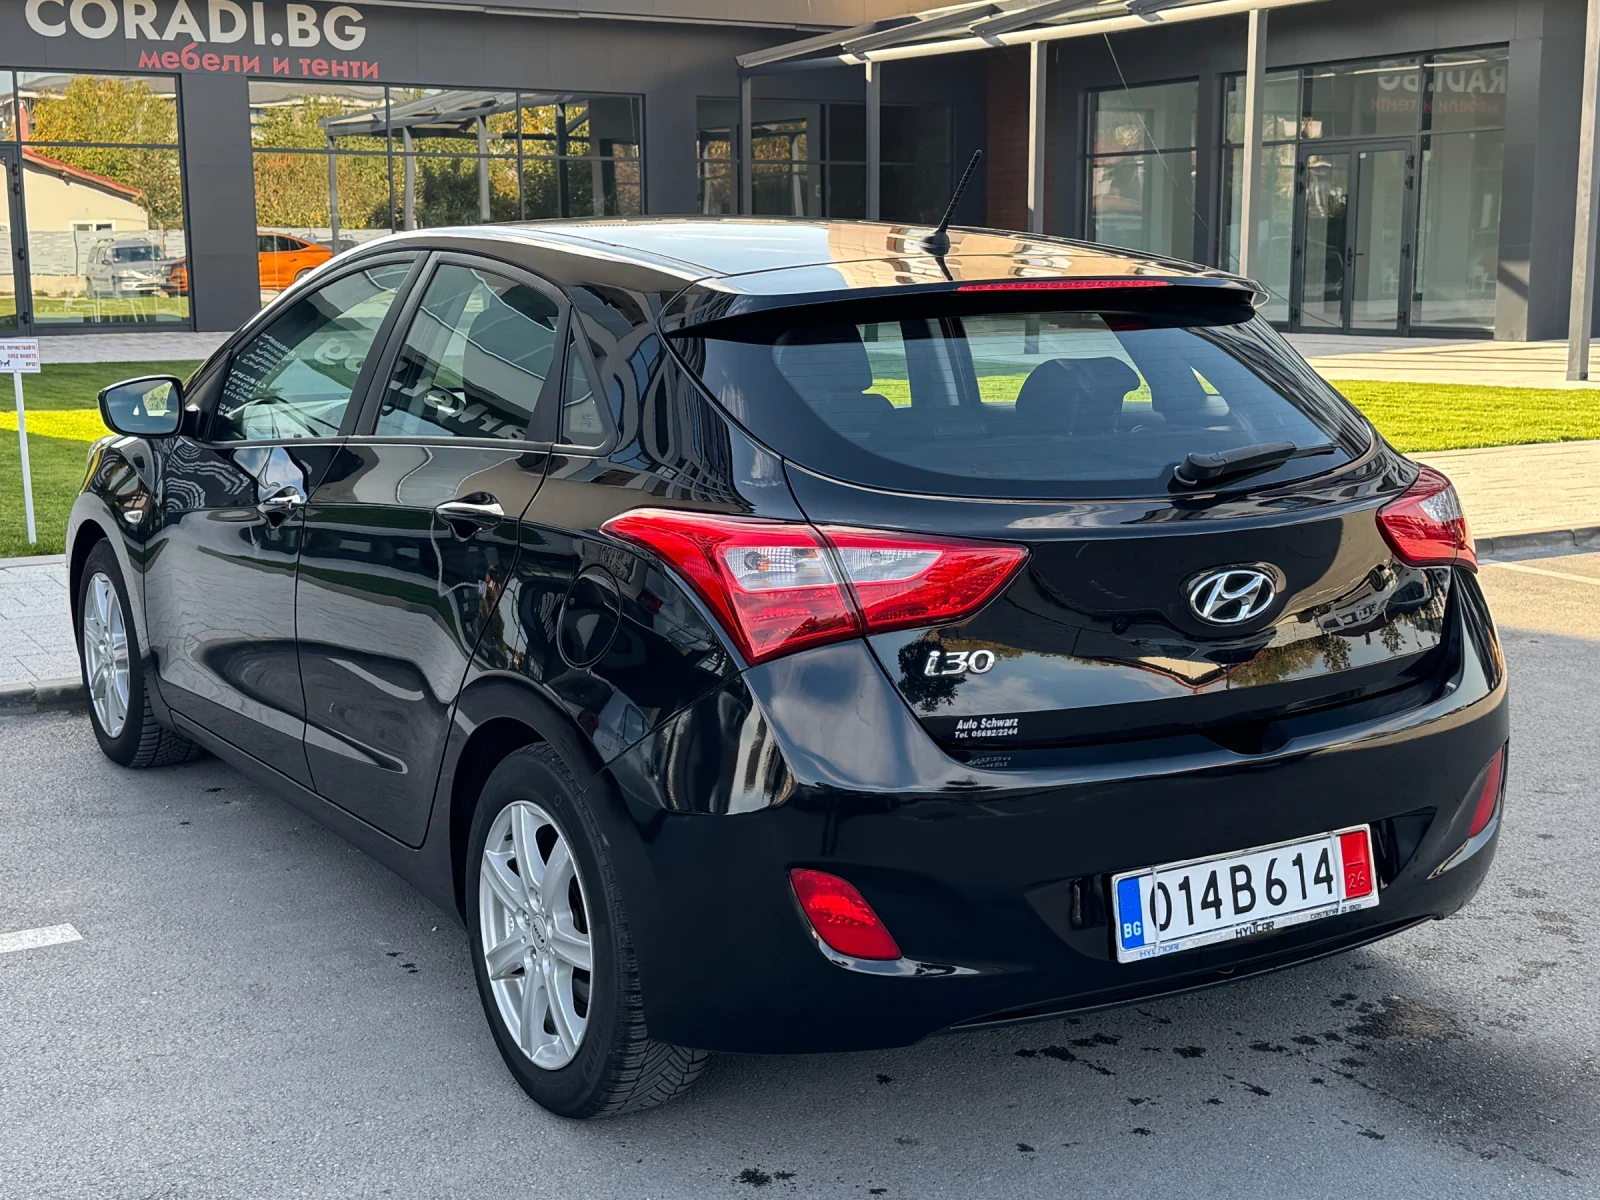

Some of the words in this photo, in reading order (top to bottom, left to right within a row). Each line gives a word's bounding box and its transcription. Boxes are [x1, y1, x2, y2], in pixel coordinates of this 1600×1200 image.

[25, 0, 366, 51] CORADI.BG
[138, 42, 260, 74] мебели
[273, 57, 290, 75] и
[299, 58, 379, 79] тенти
[924, 650, 995, 676] i30
[956, 719, 978, 730] Auto
[980, 717, 1019, 729] Schwarz
[971, 728, 1018, 738] 05692/2244
[1149, 847, 1334, 932] 014B614
[1348, 870, 1366, 890] 26
[1123, 921, 1142, 939] BG
